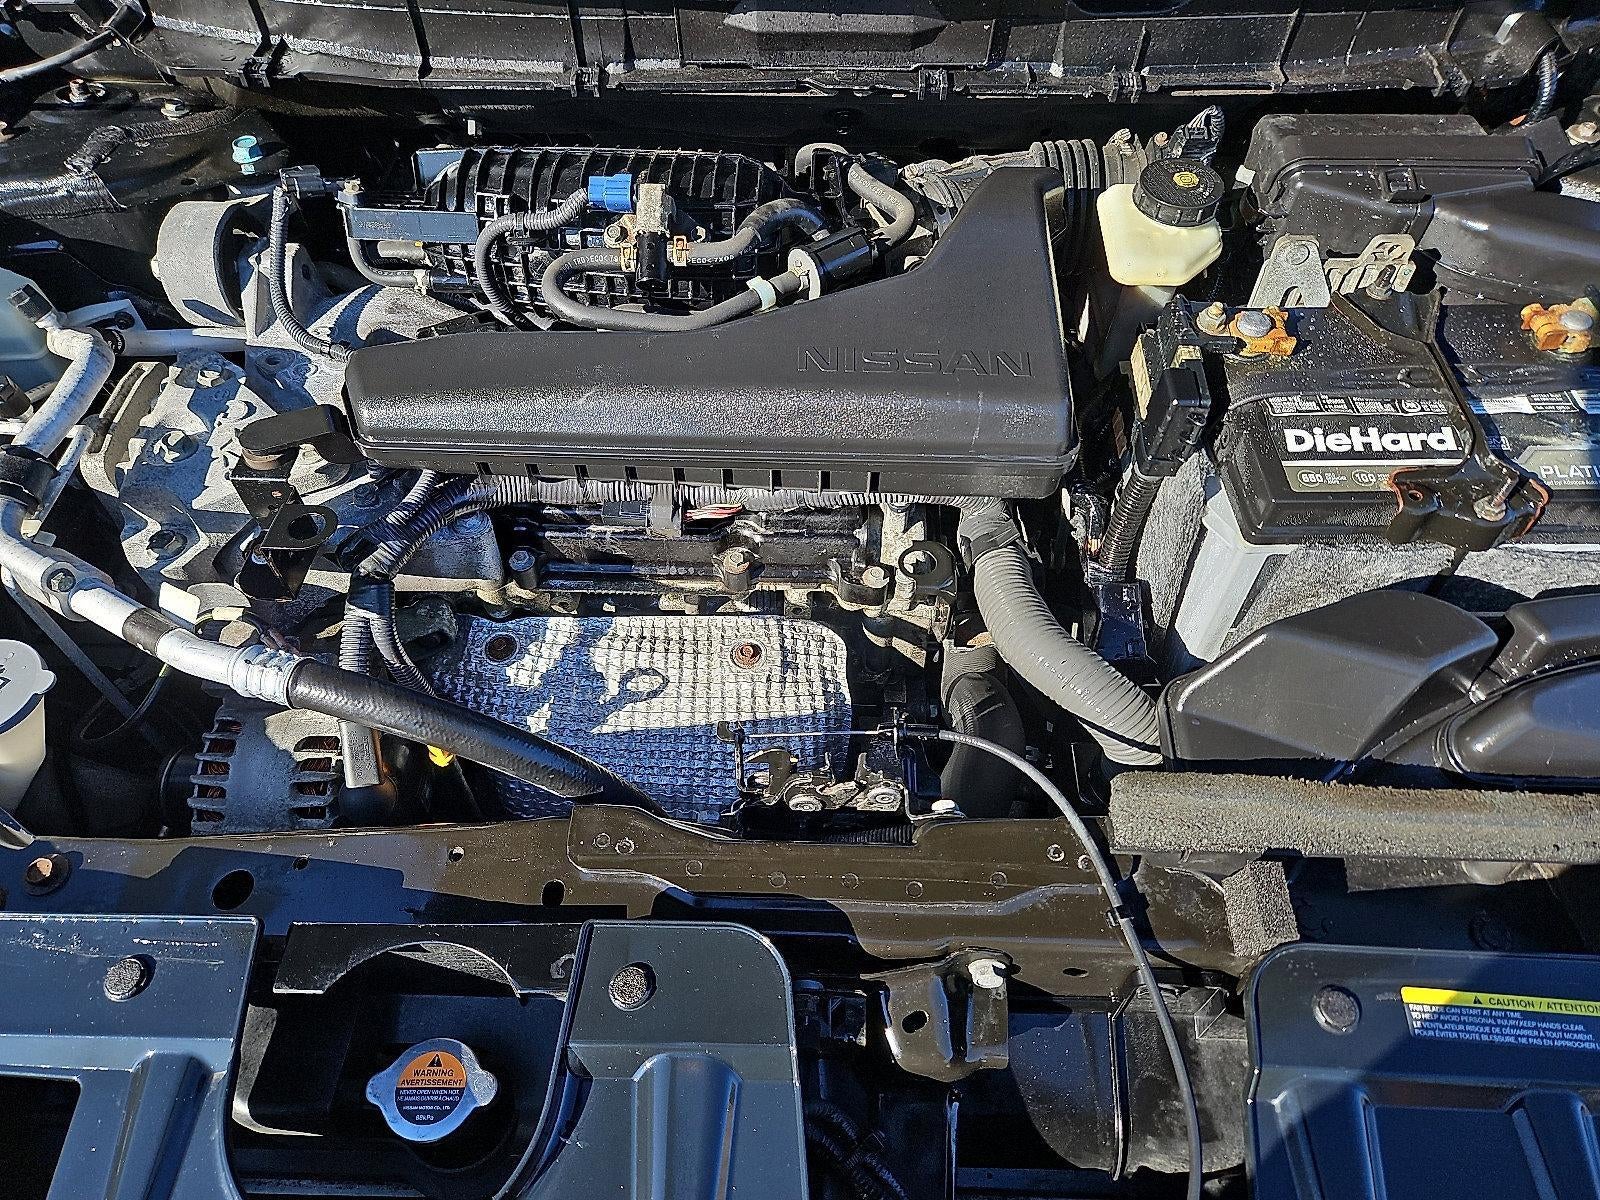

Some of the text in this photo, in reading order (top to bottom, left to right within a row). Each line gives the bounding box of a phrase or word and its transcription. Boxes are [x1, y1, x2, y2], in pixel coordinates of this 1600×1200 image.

[797, 346, 1034, 377] NISSAN
[1284, 426, 1458, 453] DieHard
[1462, 1008, 1481, 1016] START
[1492, 1010, 1506, 1018] ANY
[1488, 997, 1535, 1009] CAUTION
[1546, 1002, 1600, 1014] ATTENTION
[1411, 1012, 1421, 1020] TO
[1440, 1014, 1460, 1022] AVOID
[1461, 1016, 1496, 1025] PERSONAL
[1537, 1022, 1561, 1030] HANDS
[1415, 1029, 1435, 1037] POUR
[1458, 1032, 1480, 1041] TOUTE
[1529, 1038, 1543, 1046] PAS
[1422, 1022, 1465, 1031] VENTILATEUR
[1466, 1025, 1491, 1033] RISQUE
[1545, 1031, 1562, 1039] TOUT
[413, 1069, 454, 1077] WARNING
